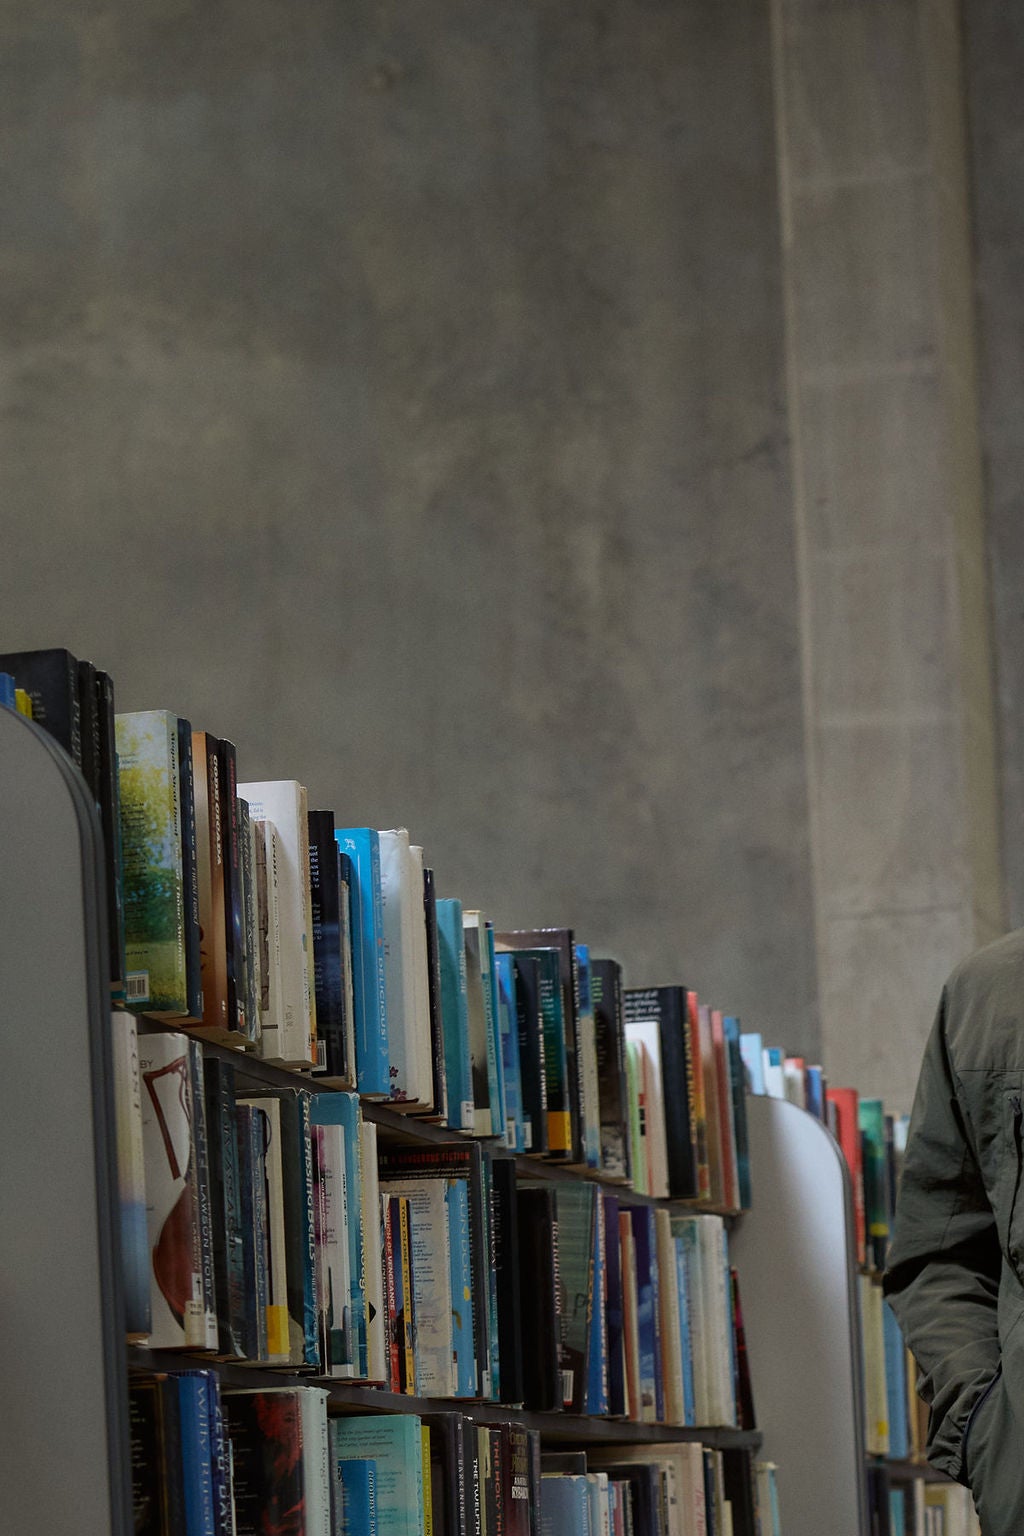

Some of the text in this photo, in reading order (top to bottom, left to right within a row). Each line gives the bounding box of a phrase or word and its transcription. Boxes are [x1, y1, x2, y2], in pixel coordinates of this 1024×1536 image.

[213, 755, 221, 800] CODE
[378, 956, 387, 1040] DELICIOUS!
[303, 1101, 316, 1261] THE PASSING BELLS
[442, 1152, 470, 1162] FICTION
[200, 1183, 213, 1297] LAWSON ROBY
[459, 1191, 467, 1234] SUN
[403, 1269, 409, 1283] TO
[552, 1221, 562, 1315] RETRIBUTION
[197, 1386, 208, 1451] Willy
[218, 1484, 228, 1531] DAY
[457, 1459, 465, 1519] DARKENING
